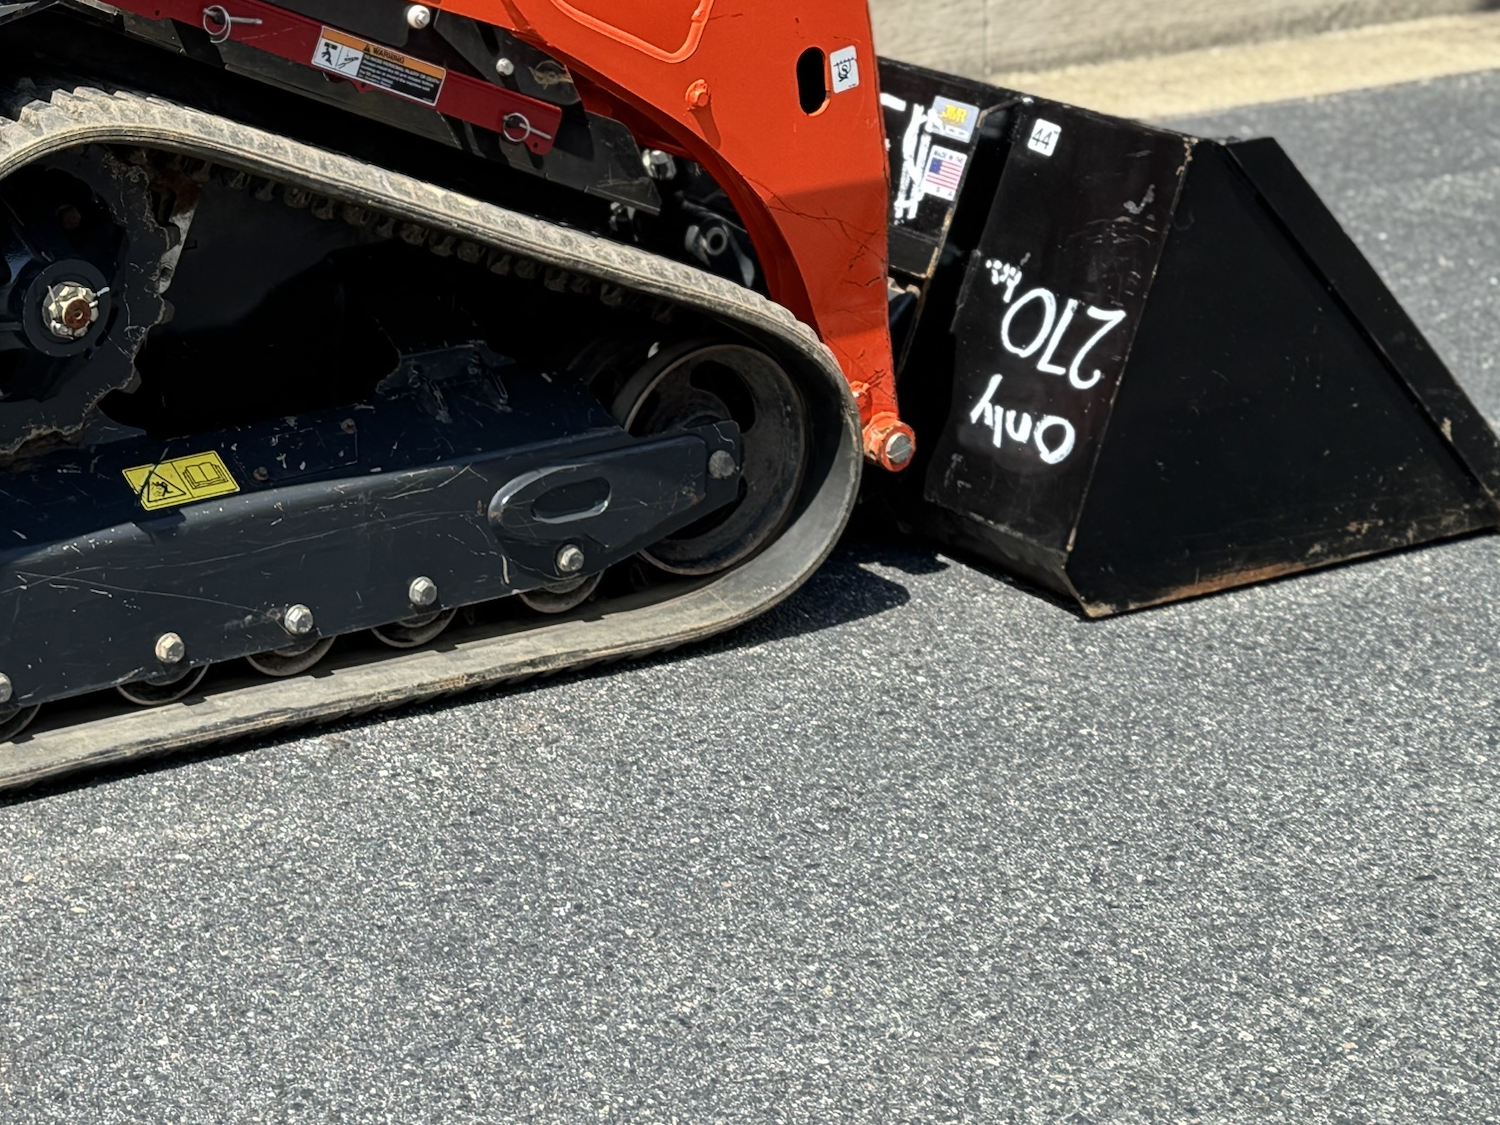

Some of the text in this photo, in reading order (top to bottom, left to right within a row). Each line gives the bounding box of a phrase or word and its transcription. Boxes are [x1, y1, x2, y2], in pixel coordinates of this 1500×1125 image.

[373, 46, 405, 65] WARNING
[1002, 287, 1127, 390] 270
[970, 374, 1076, 465] Only
